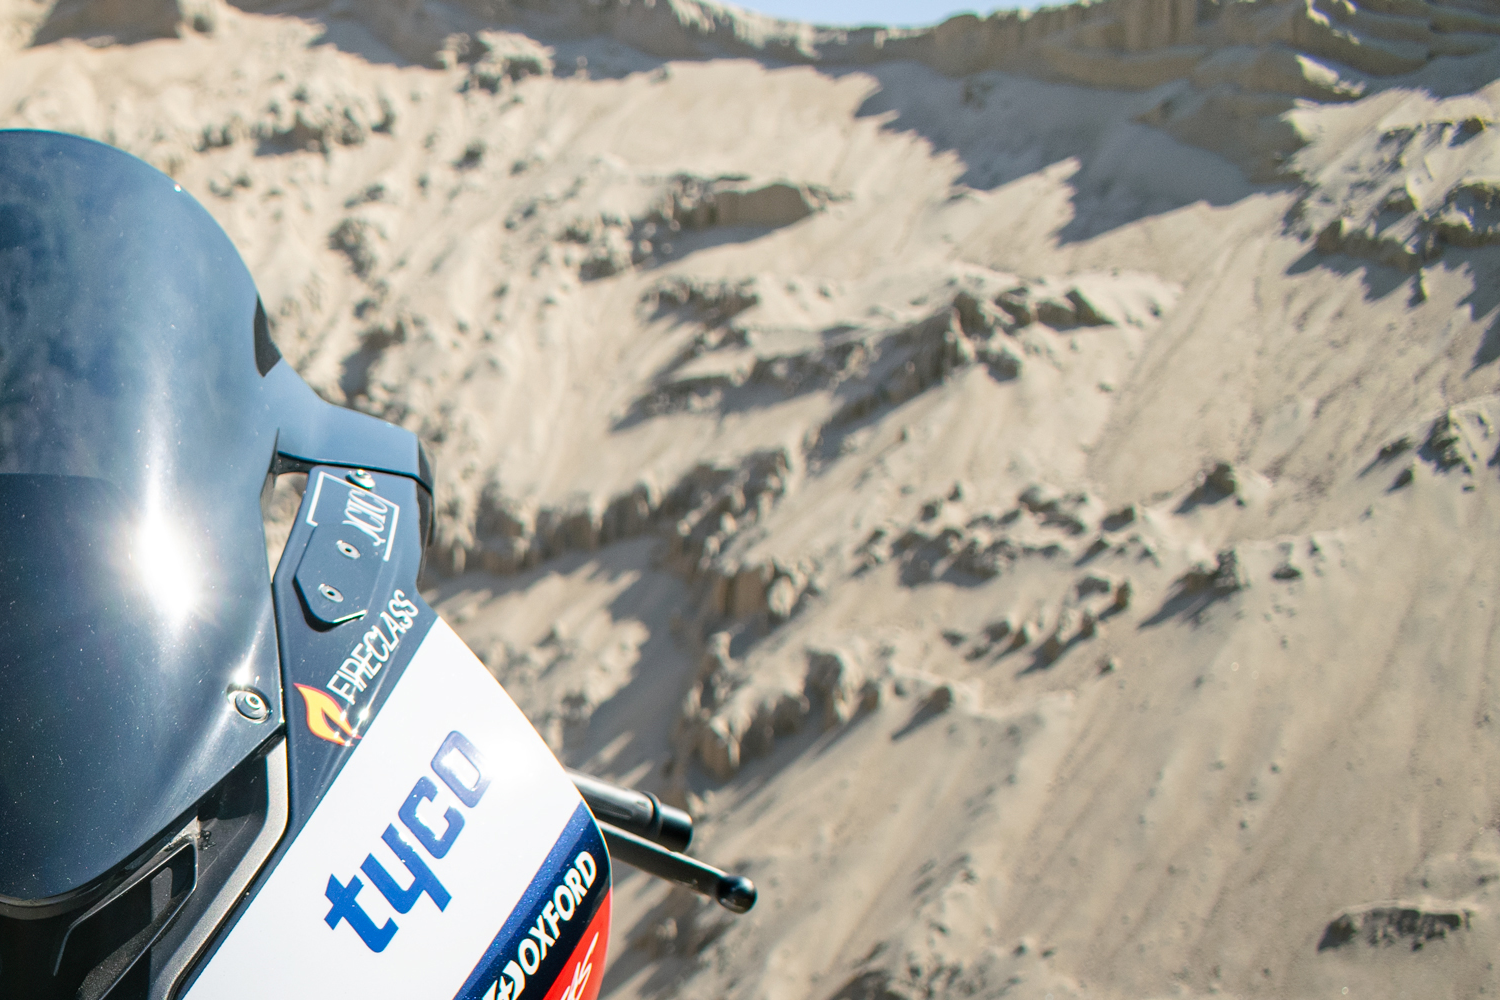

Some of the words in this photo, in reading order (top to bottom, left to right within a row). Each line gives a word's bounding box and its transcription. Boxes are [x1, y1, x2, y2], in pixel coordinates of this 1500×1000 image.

[326, 588, 419, 706] FIRECLASS
[323, 729, 494, 954] tyco
[517, 850, 598, 976] OXFORD
